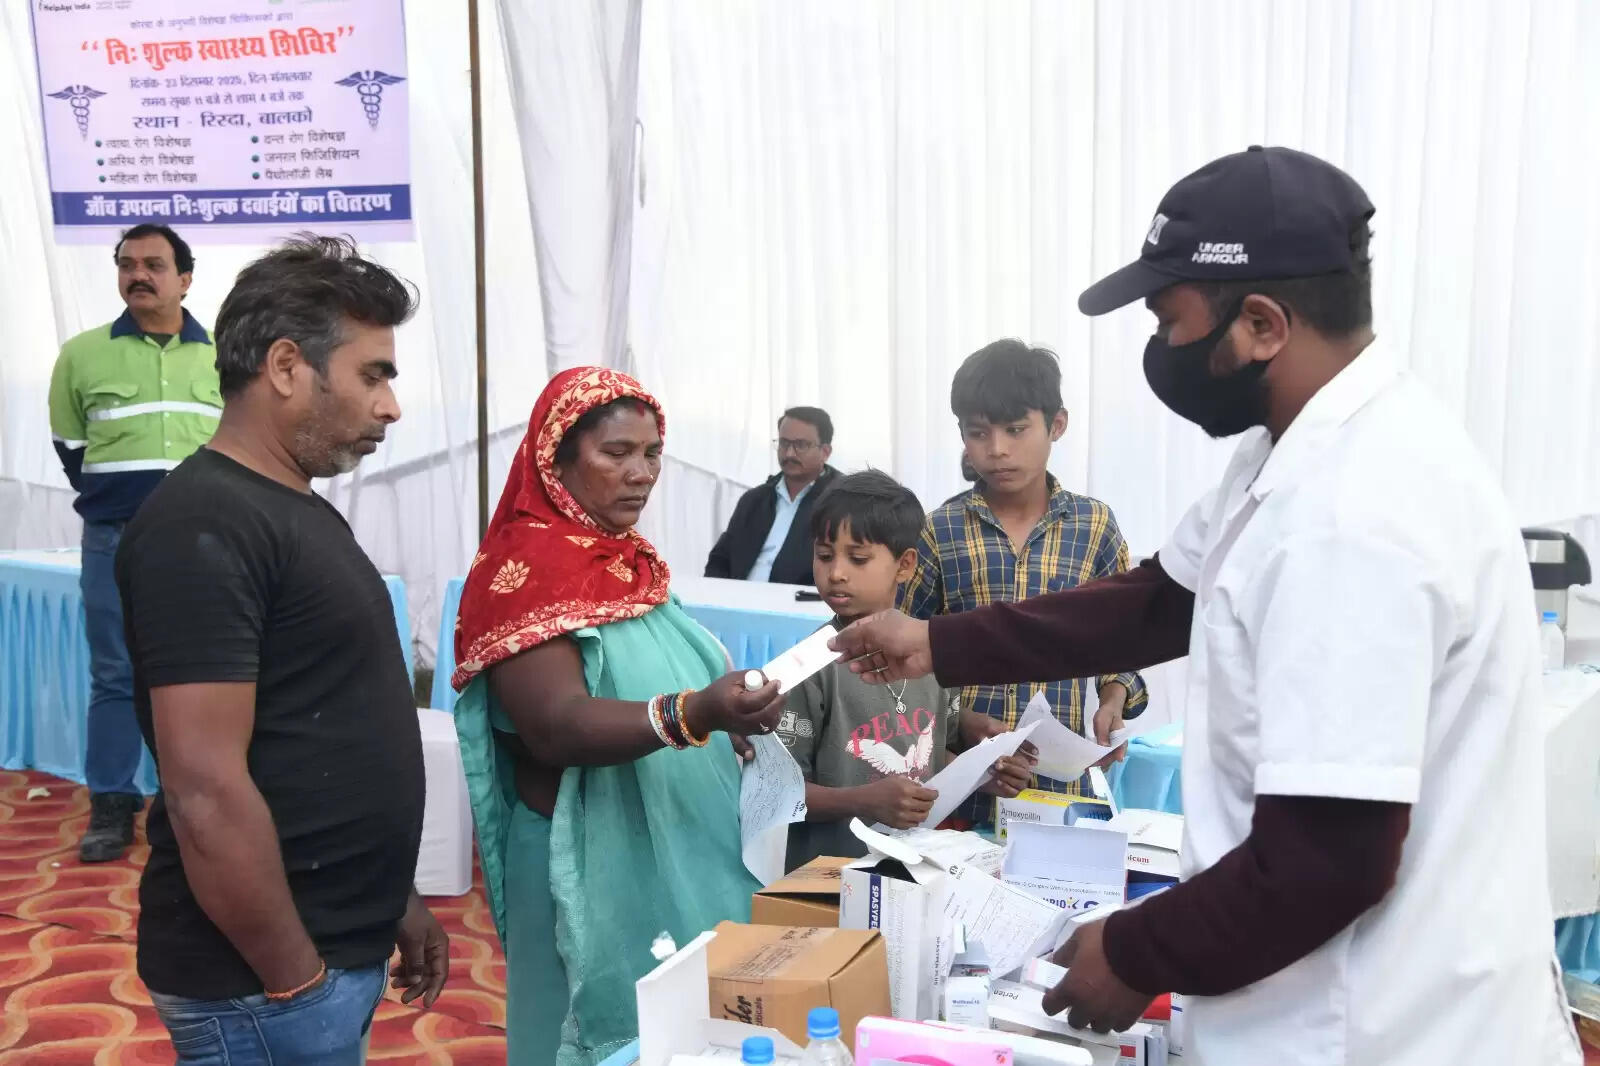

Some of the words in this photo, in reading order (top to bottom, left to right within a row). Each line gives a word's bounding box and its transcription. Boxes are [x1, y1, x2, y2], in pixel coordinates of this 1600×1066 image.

[142, 41, 193, 71] शुल्क
[197, 37, 267, 60] स्वास्थ्य
[132, 116, 179, 129] स्थान
[259, 106, 312, 124] बालको
[120, 198, 171, 217] उपरान्त
[301, 195, 325, 214] का
[327, 190, 392, 214] वितरण
[1191, 252, 1249, 264] ARMOUR
[1199, 242, 1244, 254] UNDER
